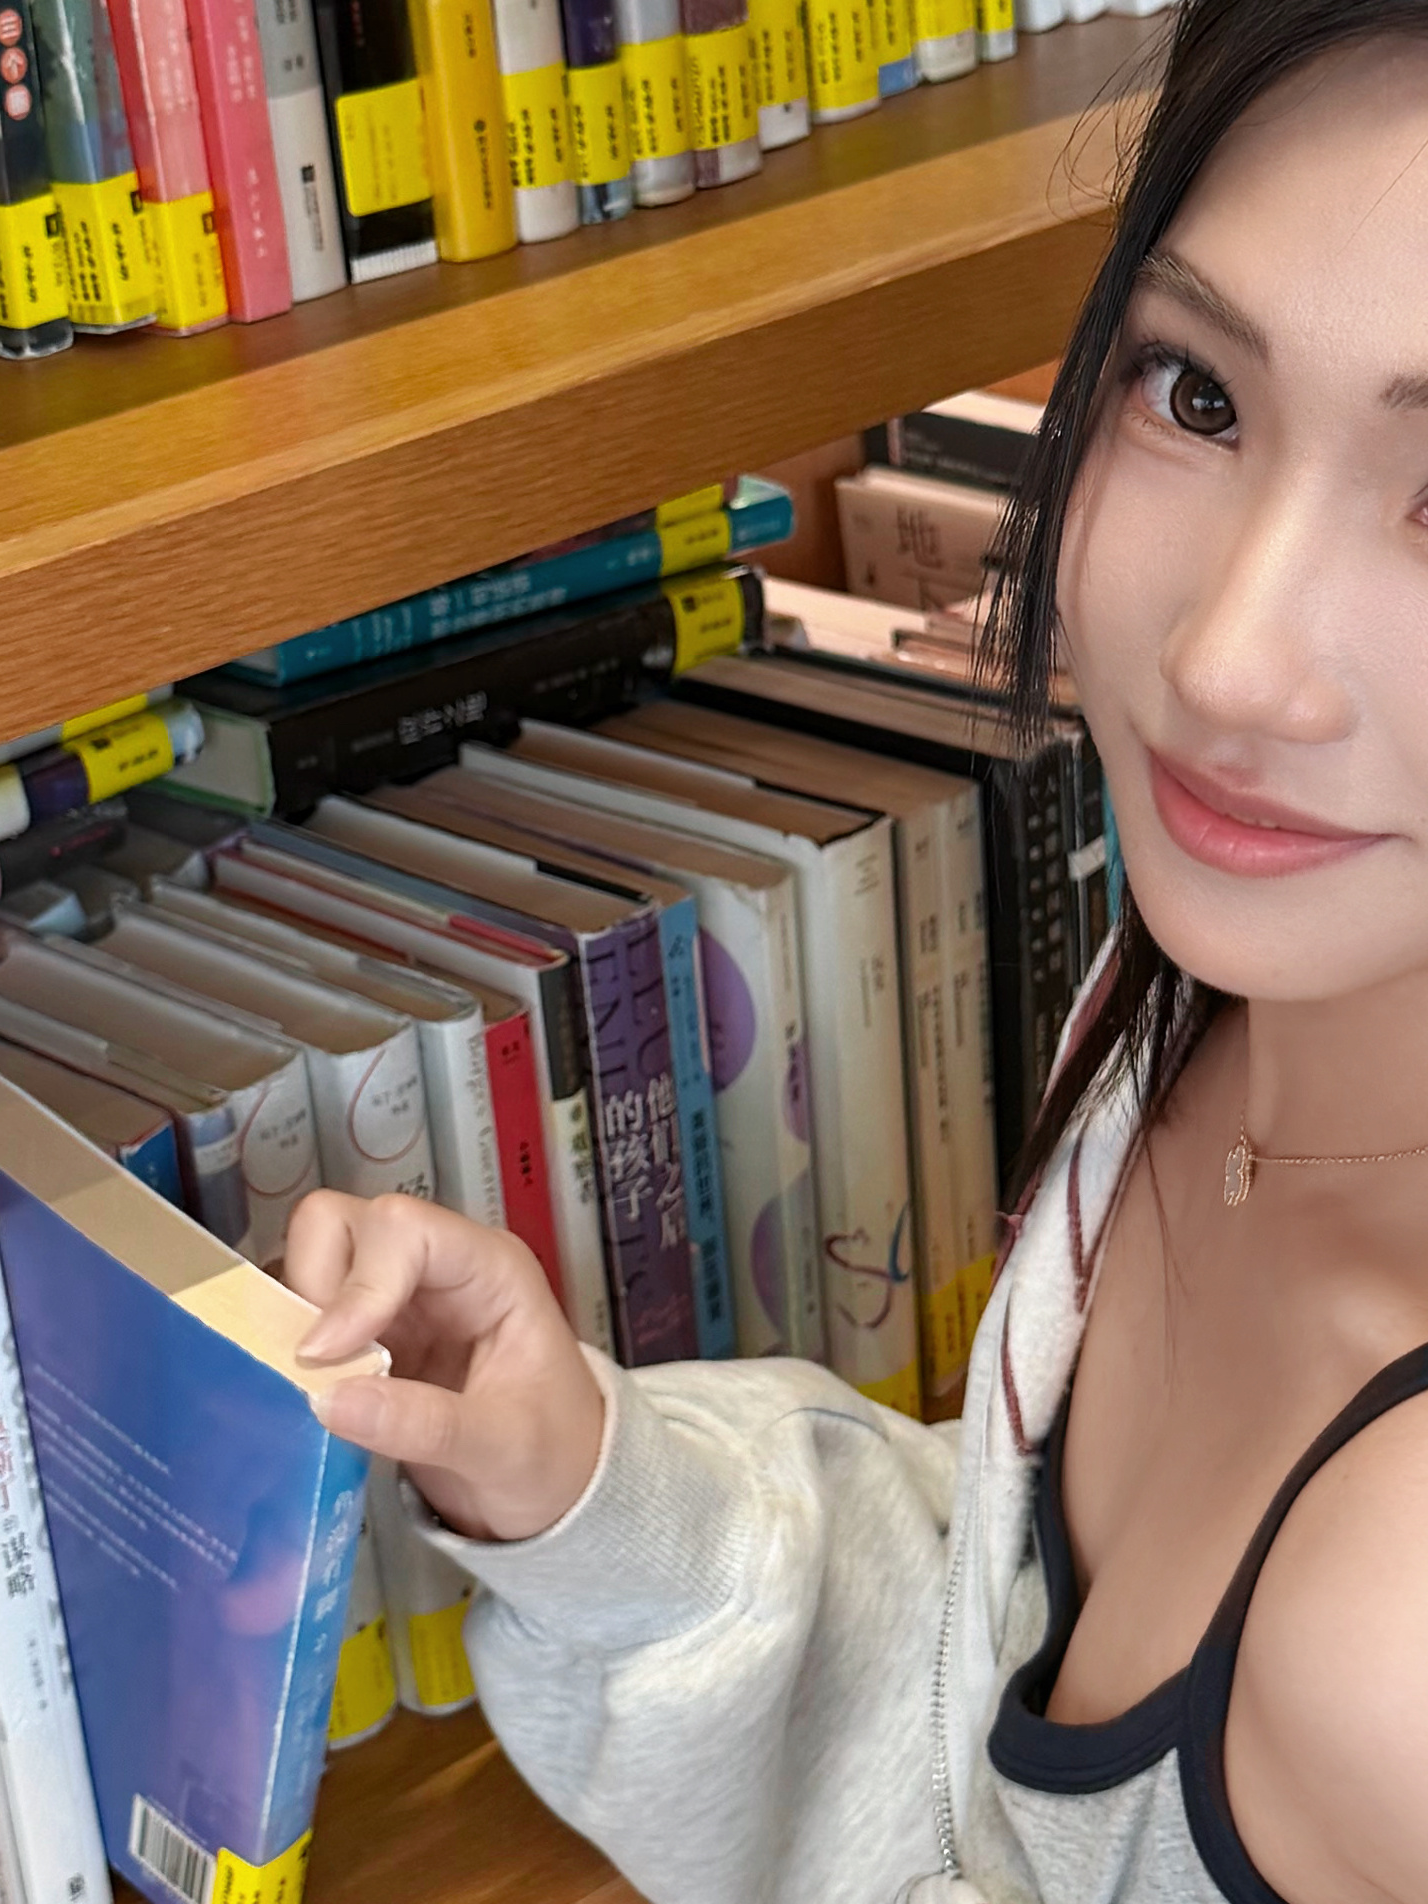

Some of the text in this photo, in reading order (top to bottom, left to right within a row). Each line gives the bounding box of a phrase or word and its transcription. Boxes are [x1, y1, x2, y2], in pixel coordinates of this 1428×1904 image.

[603, 1089, 653, 1223] 的孩子
[648, 1072, 687, 1251] 他们之后
